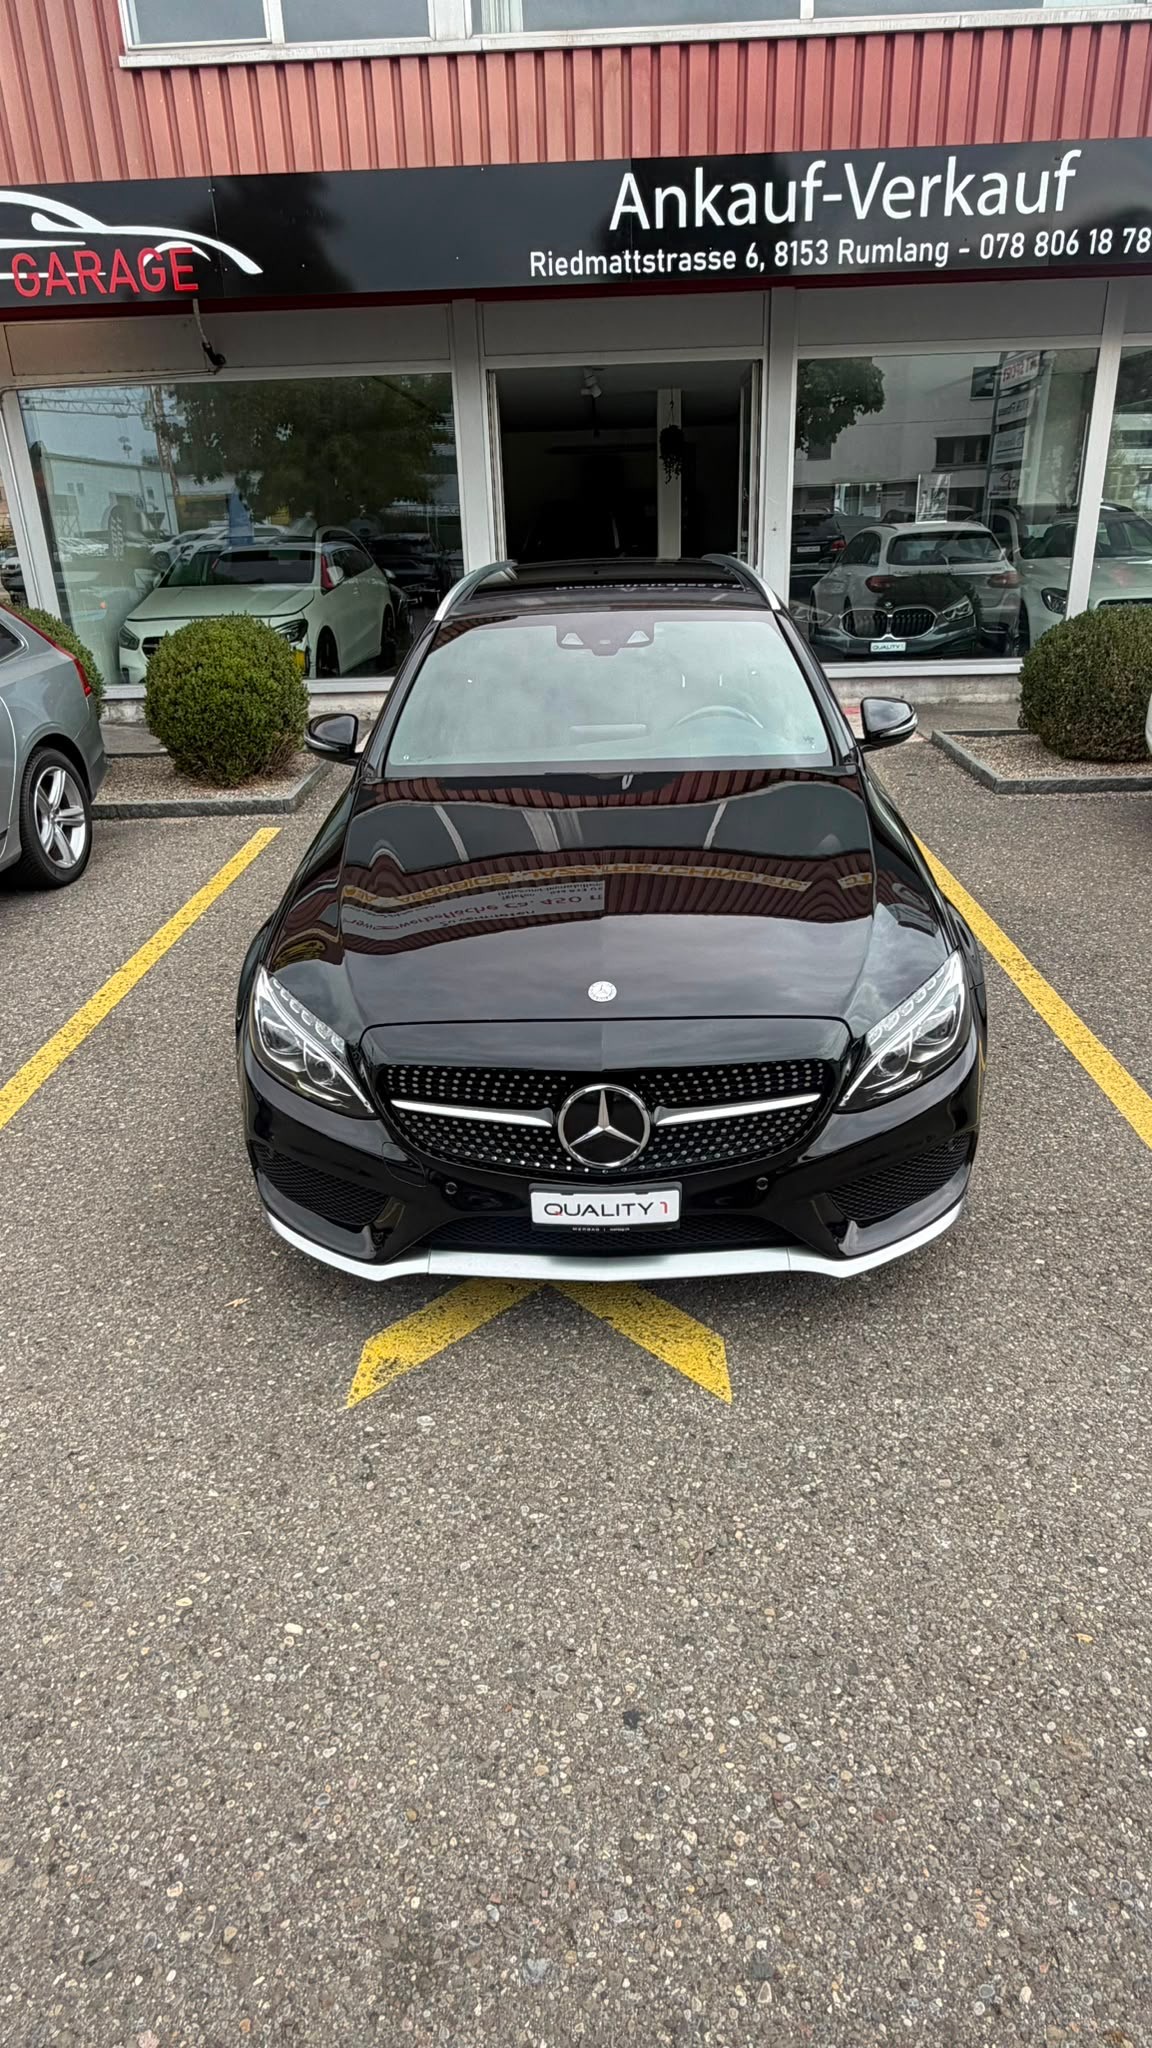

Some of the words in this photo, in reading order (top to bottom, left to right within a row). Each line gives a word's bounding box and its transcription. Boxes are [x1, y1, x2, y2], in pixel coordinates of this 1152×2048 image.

[610, 149, 1082, 230] Ankauf-Verkauf
[11, 247, 199, 298] GARAGE
[530, 249, 737, 277] Riedmattstrasse
[745, 243, 765, 273] 6,
[774, 239, 829, 267] 8153
[837, 236, 950, 268] Rumlang
[979, 231, 1026, 260] 078
[1033, 228, 1080, 258] 806
[1089, 228, 1114, 255] 18
[1122, 226, 1152, 254] 78
[544, 1202, 654, 1217] QUALITY
[659, 1201, 668, 1215] 1
